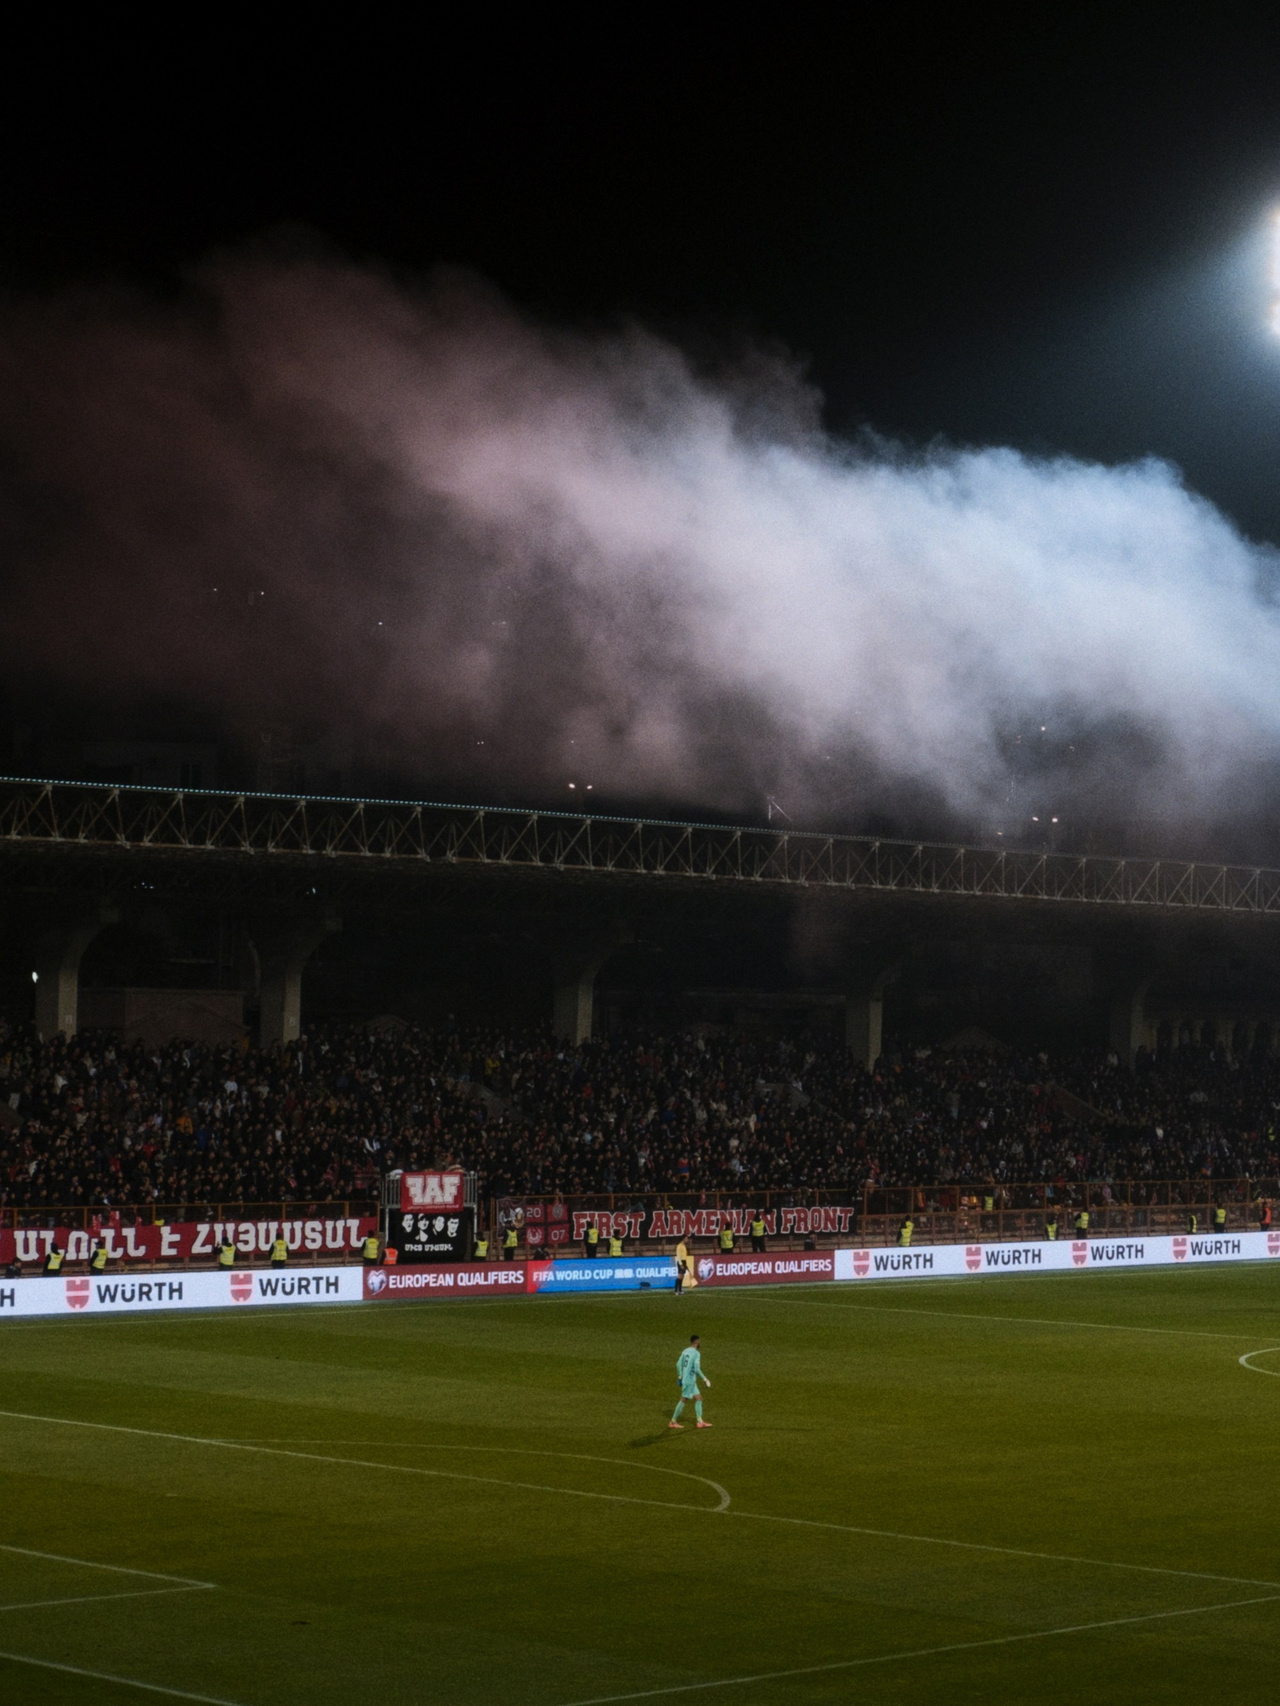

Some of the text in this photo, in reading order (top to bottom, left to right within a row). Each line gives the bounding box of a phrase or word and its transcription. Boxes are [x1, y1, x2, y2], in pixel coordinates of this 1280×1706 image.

[526, 1207, 541, 1218] 20
[573, 1207, 854, 1240] FIRST ARMENIAN FRONT
[551, 1229, 566, 1241] 07
[1090, 1244, 1144, 1260] WÜRTH
[1190, 1239, 1241, 1255] WÜRTH
[874, 1253, 934, 1271] WÜRTH
[985, 1249, 1042, 1266] WÜRTH
[533, 1269, 554, 1282] FIFA
[555, 1269, 592, 1282] WORLD
[593, 1268, 613, 1280] CUP
[635, 1266, 679, 1278] QUALIFIE
[716, 1259, 832, 1276] EUROPEAN QUALIFIERS
[257, 1275, 340, 1298] WÜRTH
[389, 1270, 525, 1288] EUROPEAN QUALIFIERS
[96, 1281, 184, 1304] WÜRTH
